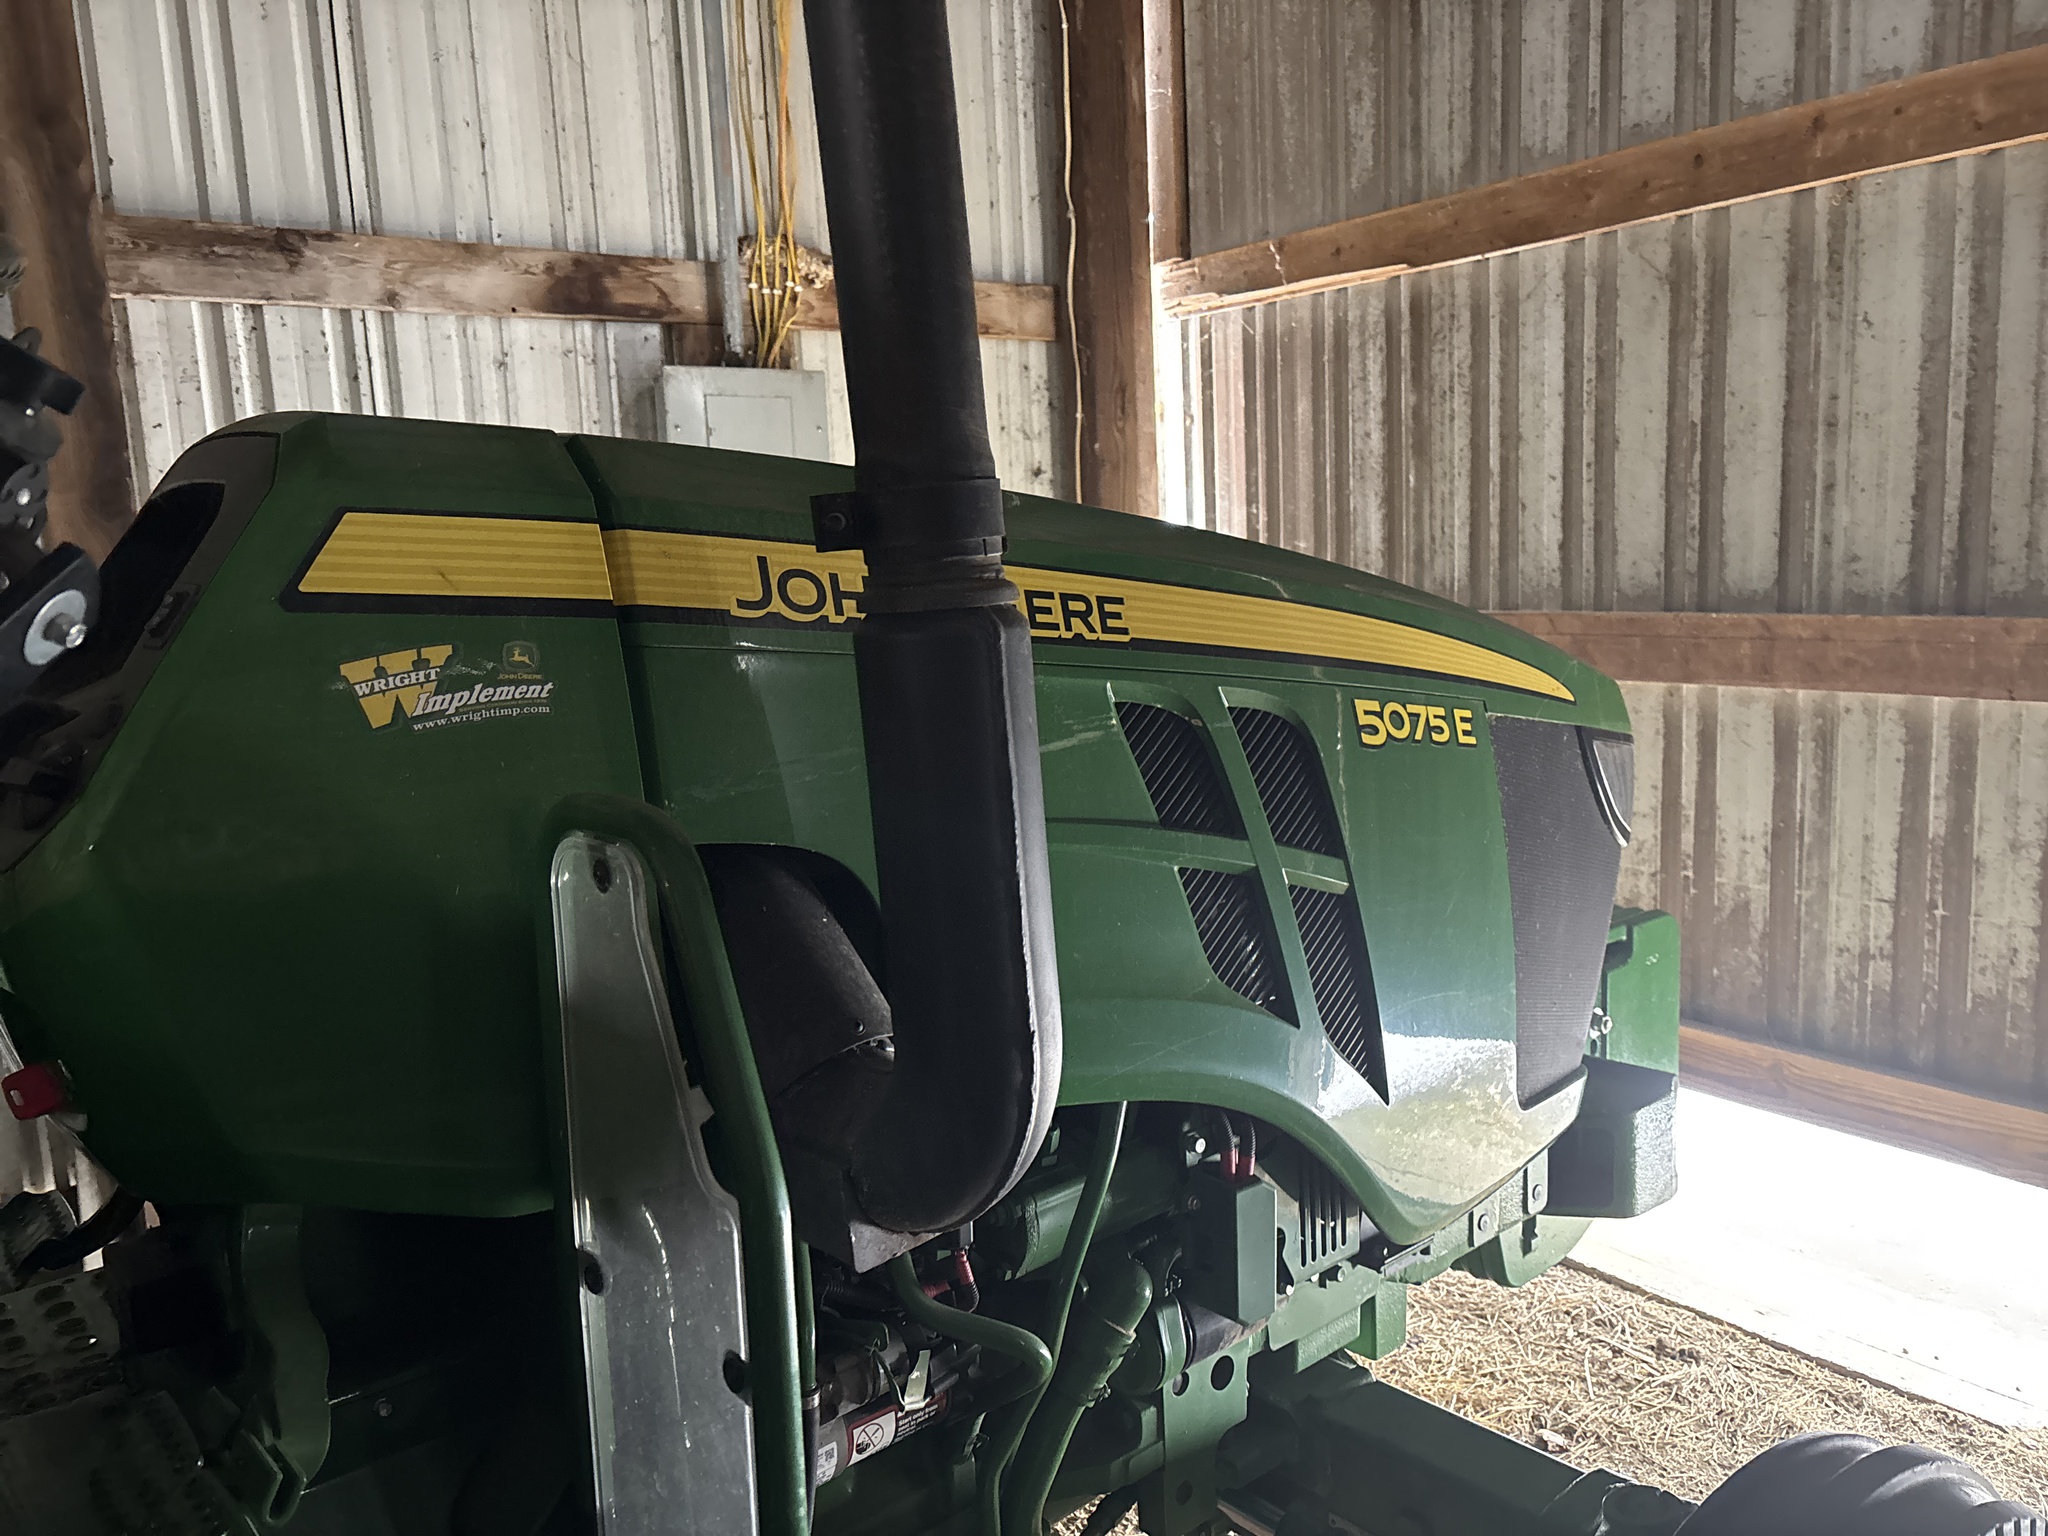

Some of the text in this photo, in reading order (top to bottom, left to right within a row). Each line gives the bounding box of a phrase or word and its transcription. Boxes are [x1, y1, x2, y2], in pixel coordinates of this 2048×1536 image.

[736, 555, 1131, 636] JOH ERE
[353, 667, 441, 698] WRIGHT
[411, 682, 554, 718] Implement
[412, 704, 551, 732] www.wrightimp.com
